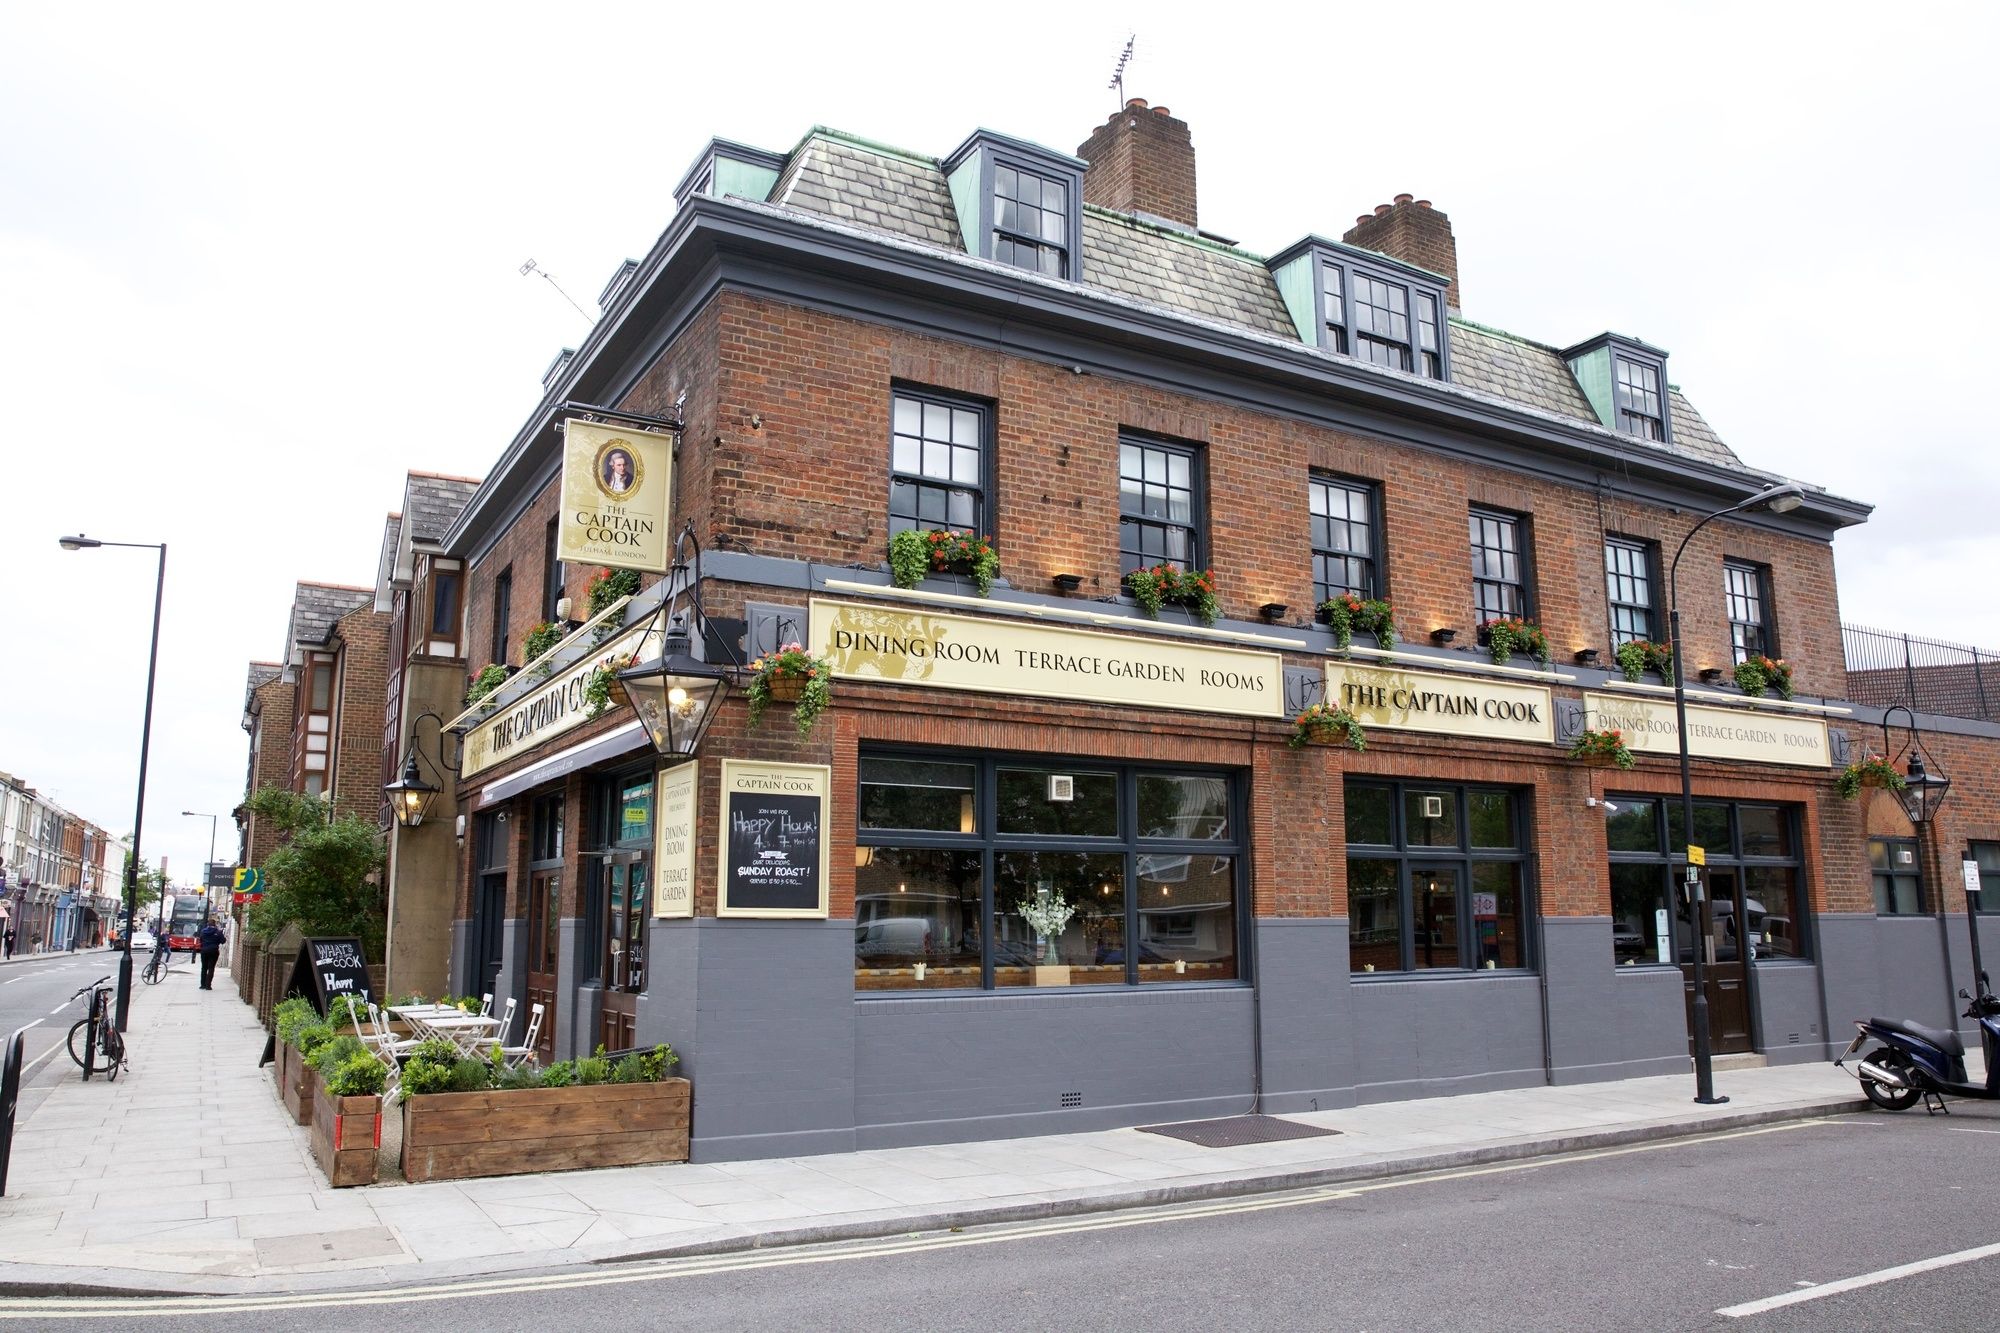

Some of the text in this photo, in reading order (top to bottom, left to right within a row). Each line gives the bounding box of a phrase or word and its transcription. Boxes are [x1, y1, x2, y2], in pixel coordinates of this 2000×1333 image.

[606, 505, 626, 515] THE
[576, 511, 653, 534] CAPTAIN
[586, 527, 641, 547] COOK
[614, 550, 647, 560] LONDON
[836, 630, 1264, 692] DINING ROOM TERRACE GARDEN ROOMS
[1342, 683, 1541, 723] THE CAPTAIN COOK
[492, 715, 513, 753] THE
[514, 684, 566, 741] CAPTAIN
[1599, 714, 1644, 732] DINING
[1688, 723, 1733, 740] TERRACE
[1735, 728, 1777, 744] GARDEN
[1784, 735, 1819, 749] ROOMS
[737, 779, 814, 791] CAPTAIN COOK
[665, 823, 688, 840] DINING
[666, 840, 685, 855] ROOM
[663, 868, 688, 884] TERRACE
[737, 866, 772, 877] SUNDAY
[662, 886, 687, 901] GARDEN
[333, 955, 362, 968] COOK
